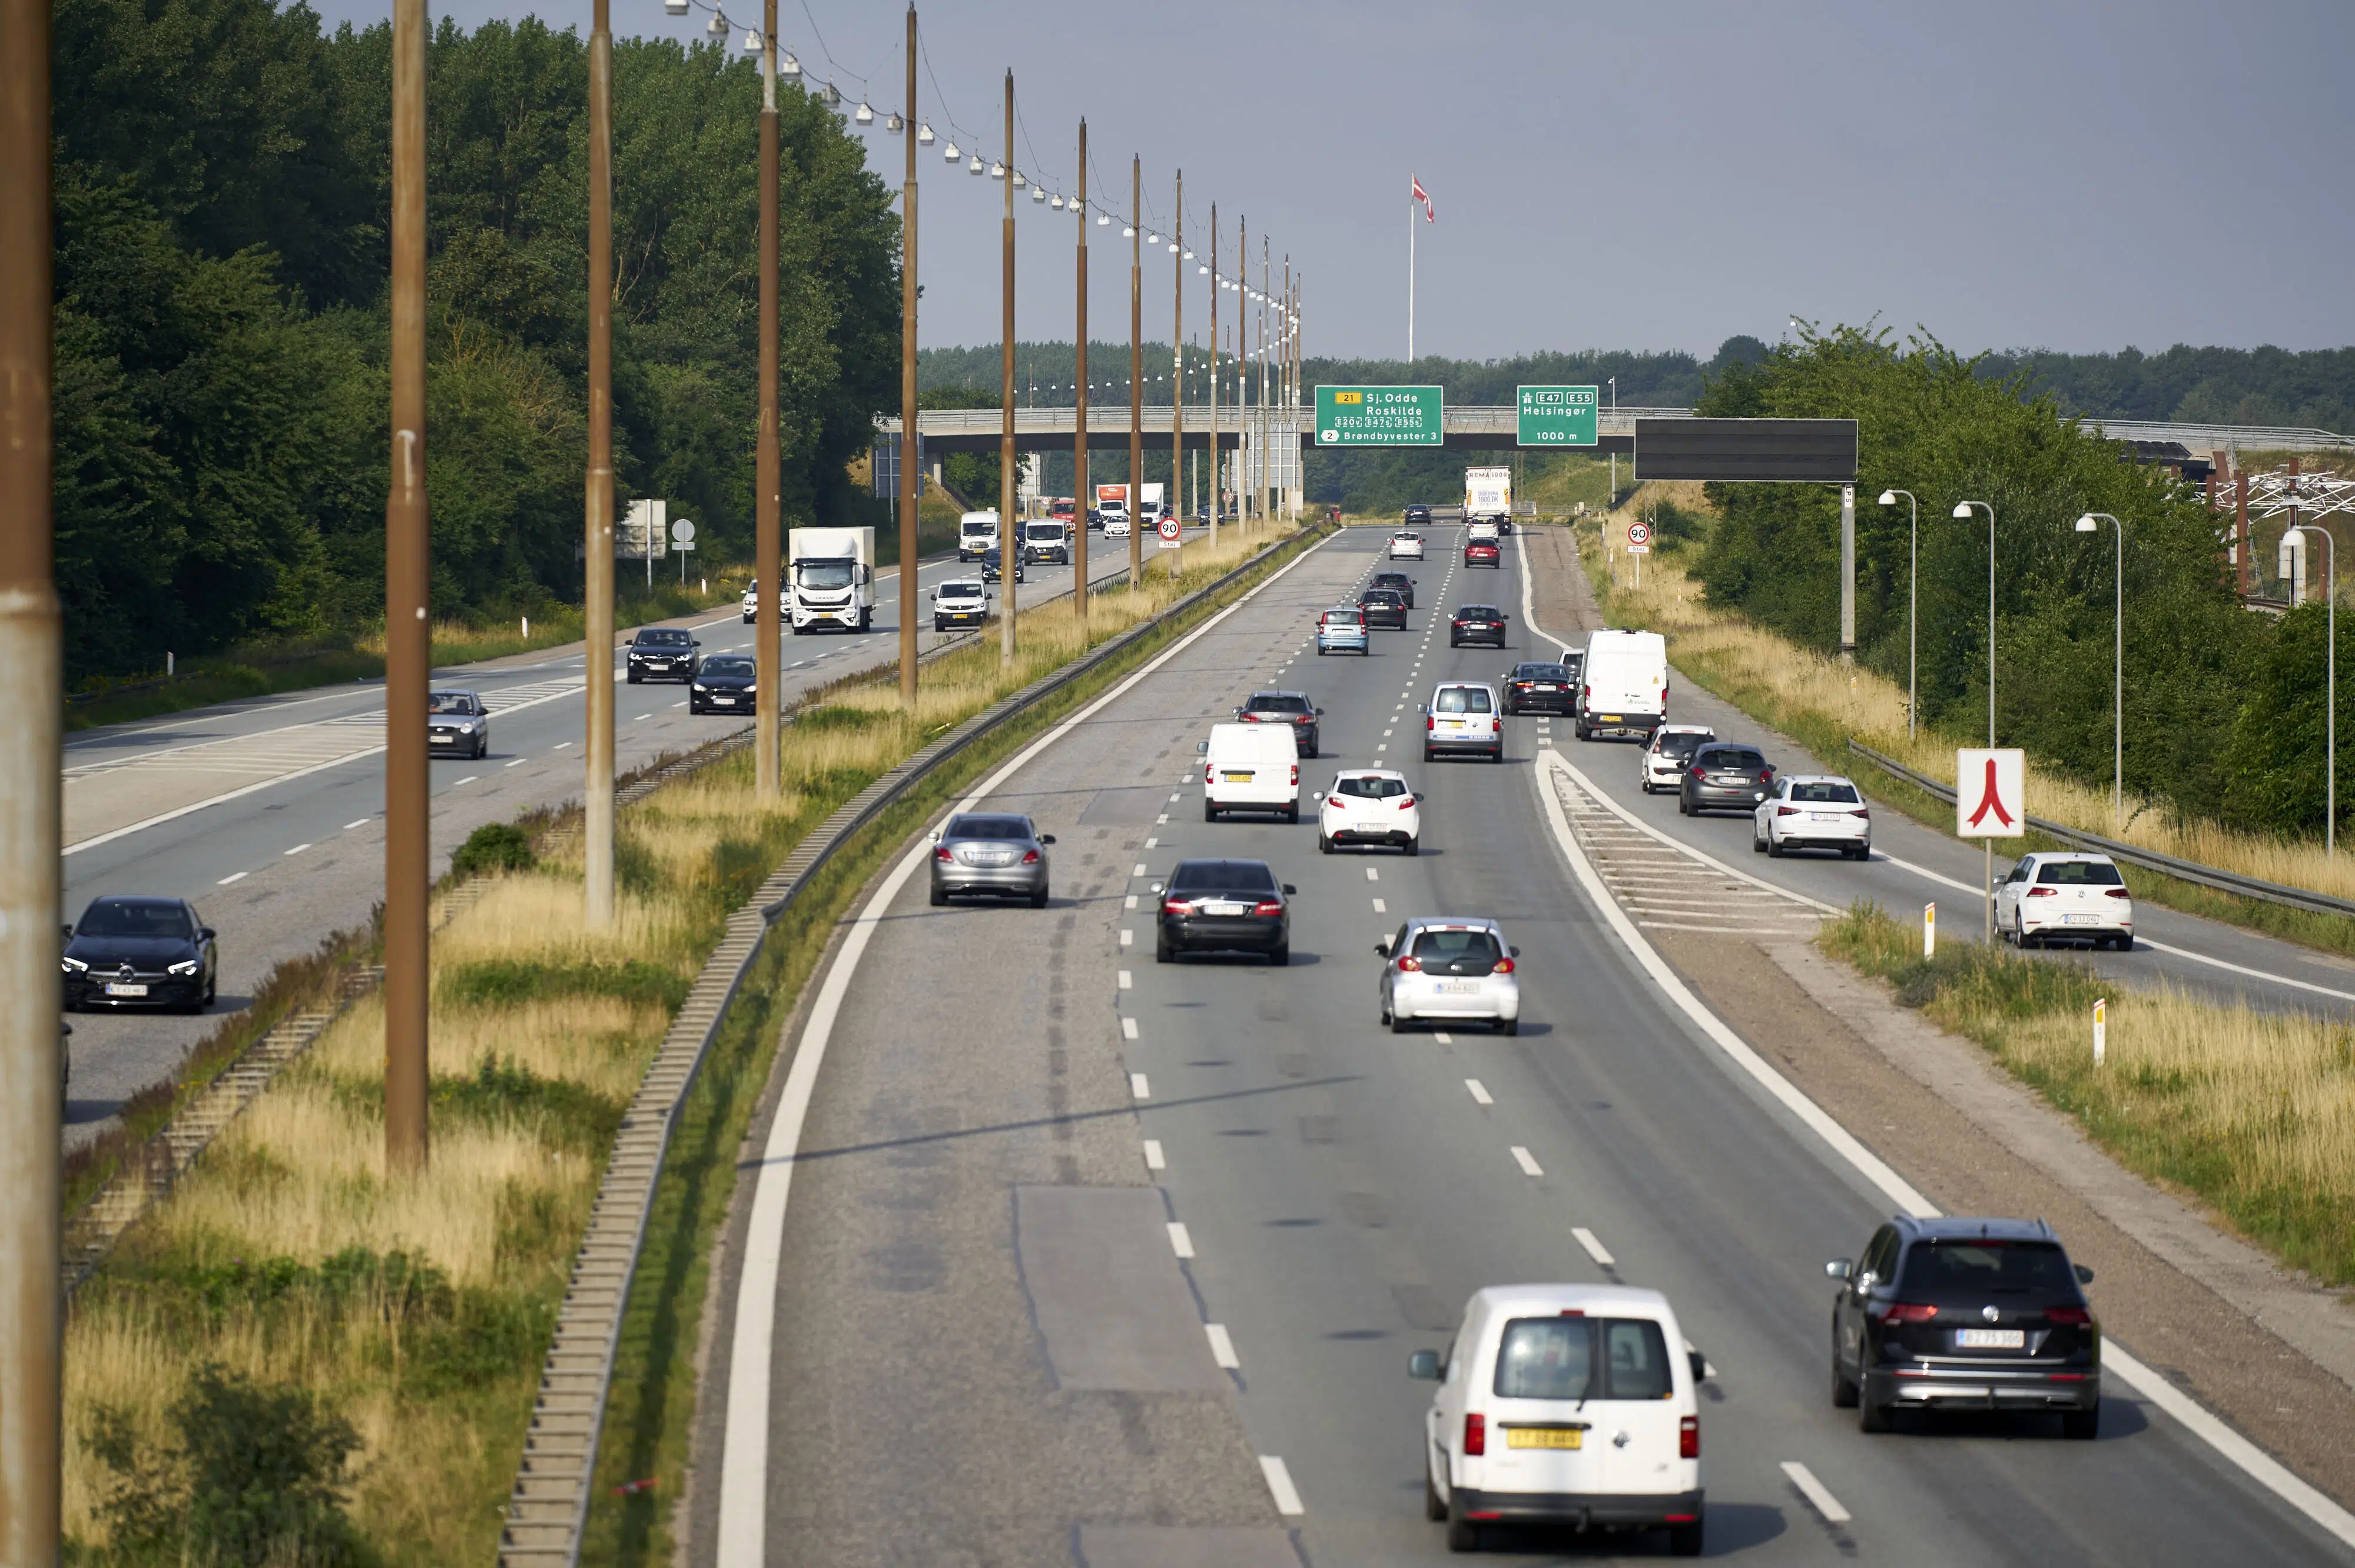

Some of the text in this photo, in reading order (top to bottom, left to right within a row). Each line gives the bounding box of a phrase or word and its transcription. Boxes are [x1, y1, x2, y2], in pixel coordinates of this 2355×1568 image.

[1366, 393, 1418, 404] Sj. Odde
[1540, 394, 1560, 402] E47
[1570, 394, 1590, 402] E55
[1366, 406, 1422, 416] Roskilde
[1524, 406, 1586, 417] Helsingør
[1344, 432, 1425, 441] Brøndbyvester
[1537, 431, 1564, 440] 1000
[1163, 524, 1177, 533] 90
[1631, 529, 1646, 538] 90
